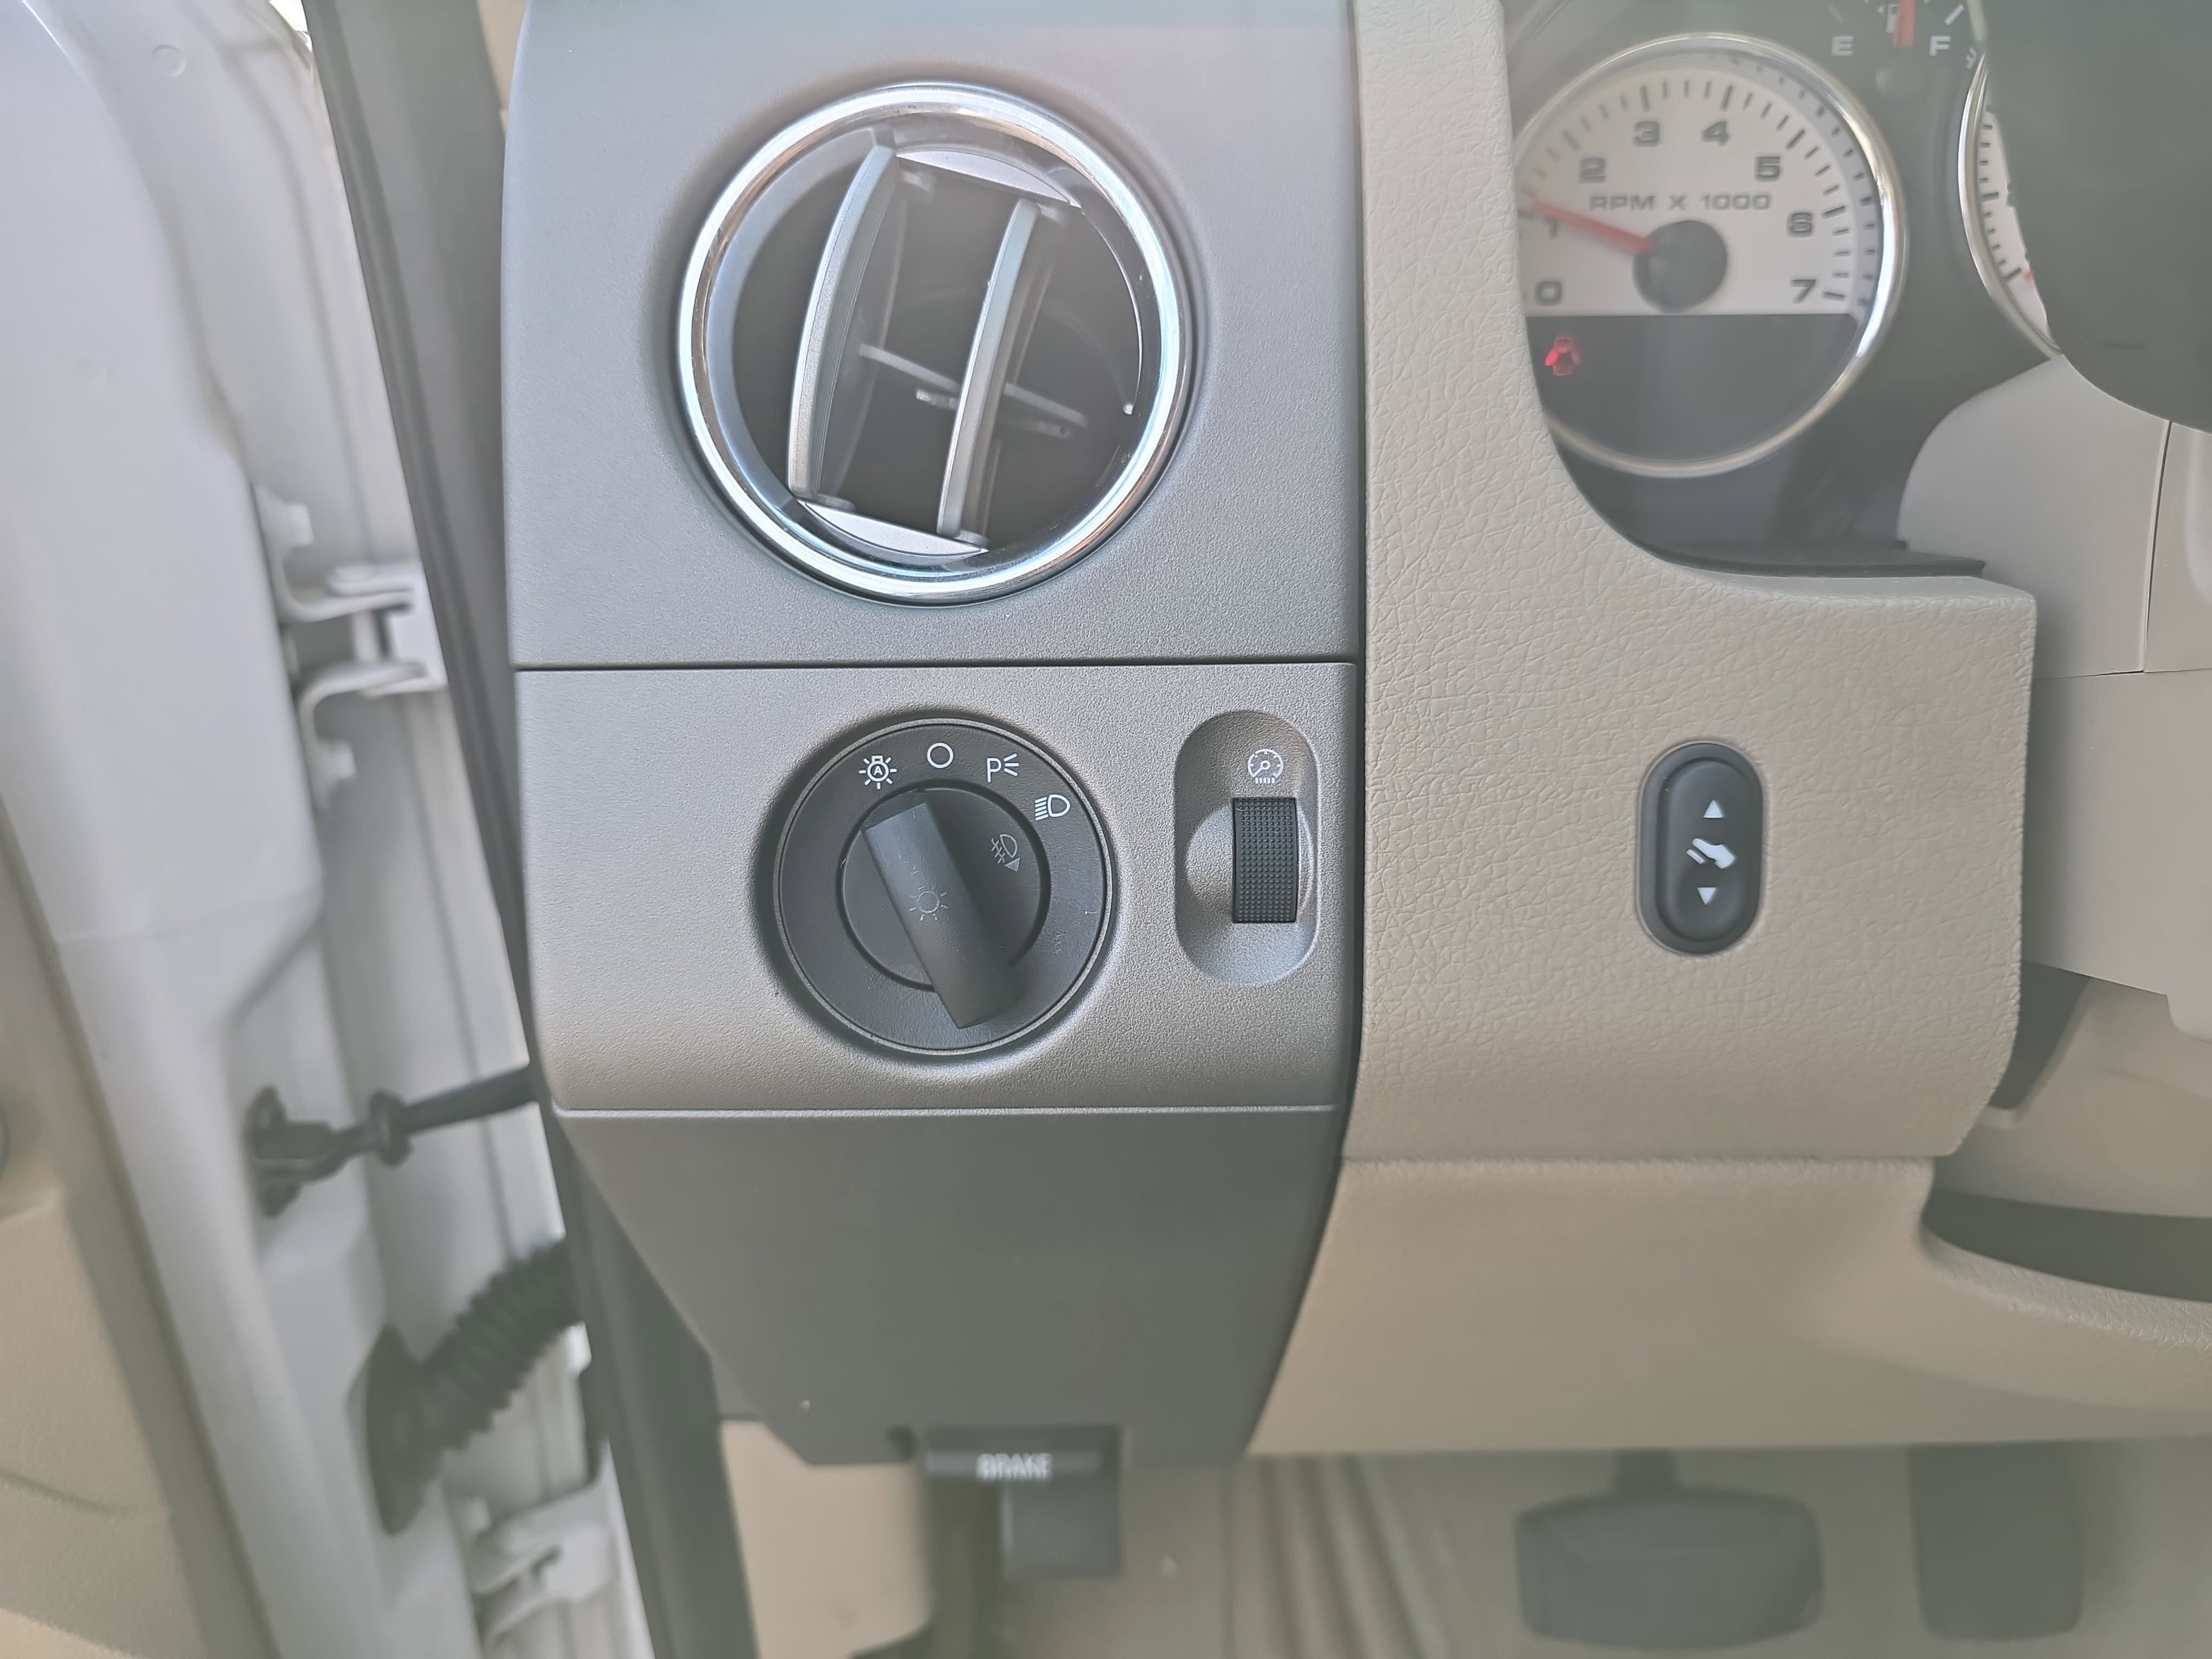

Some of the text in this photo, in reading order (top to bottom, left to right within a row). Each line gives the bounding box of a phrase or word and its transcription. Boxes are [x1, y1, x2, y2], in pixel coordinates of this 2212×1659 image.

[1929, 36, 1951, 56] F
[1632, 120, 1660, 147] 3
[1701, 120, 1729, 147] 4
[1579, 157, 1606, 184] 2
[1754, 156, 1781, 182] 5
[1589, 194, 1771, 211] RPM X 1000
[1787, 212, 1814, 237] 6
[1534, 280, 1564, 307] 0
[1790, 278, 1818, 304] 7
[978, 1453, 1053, 1479] BRAKE
